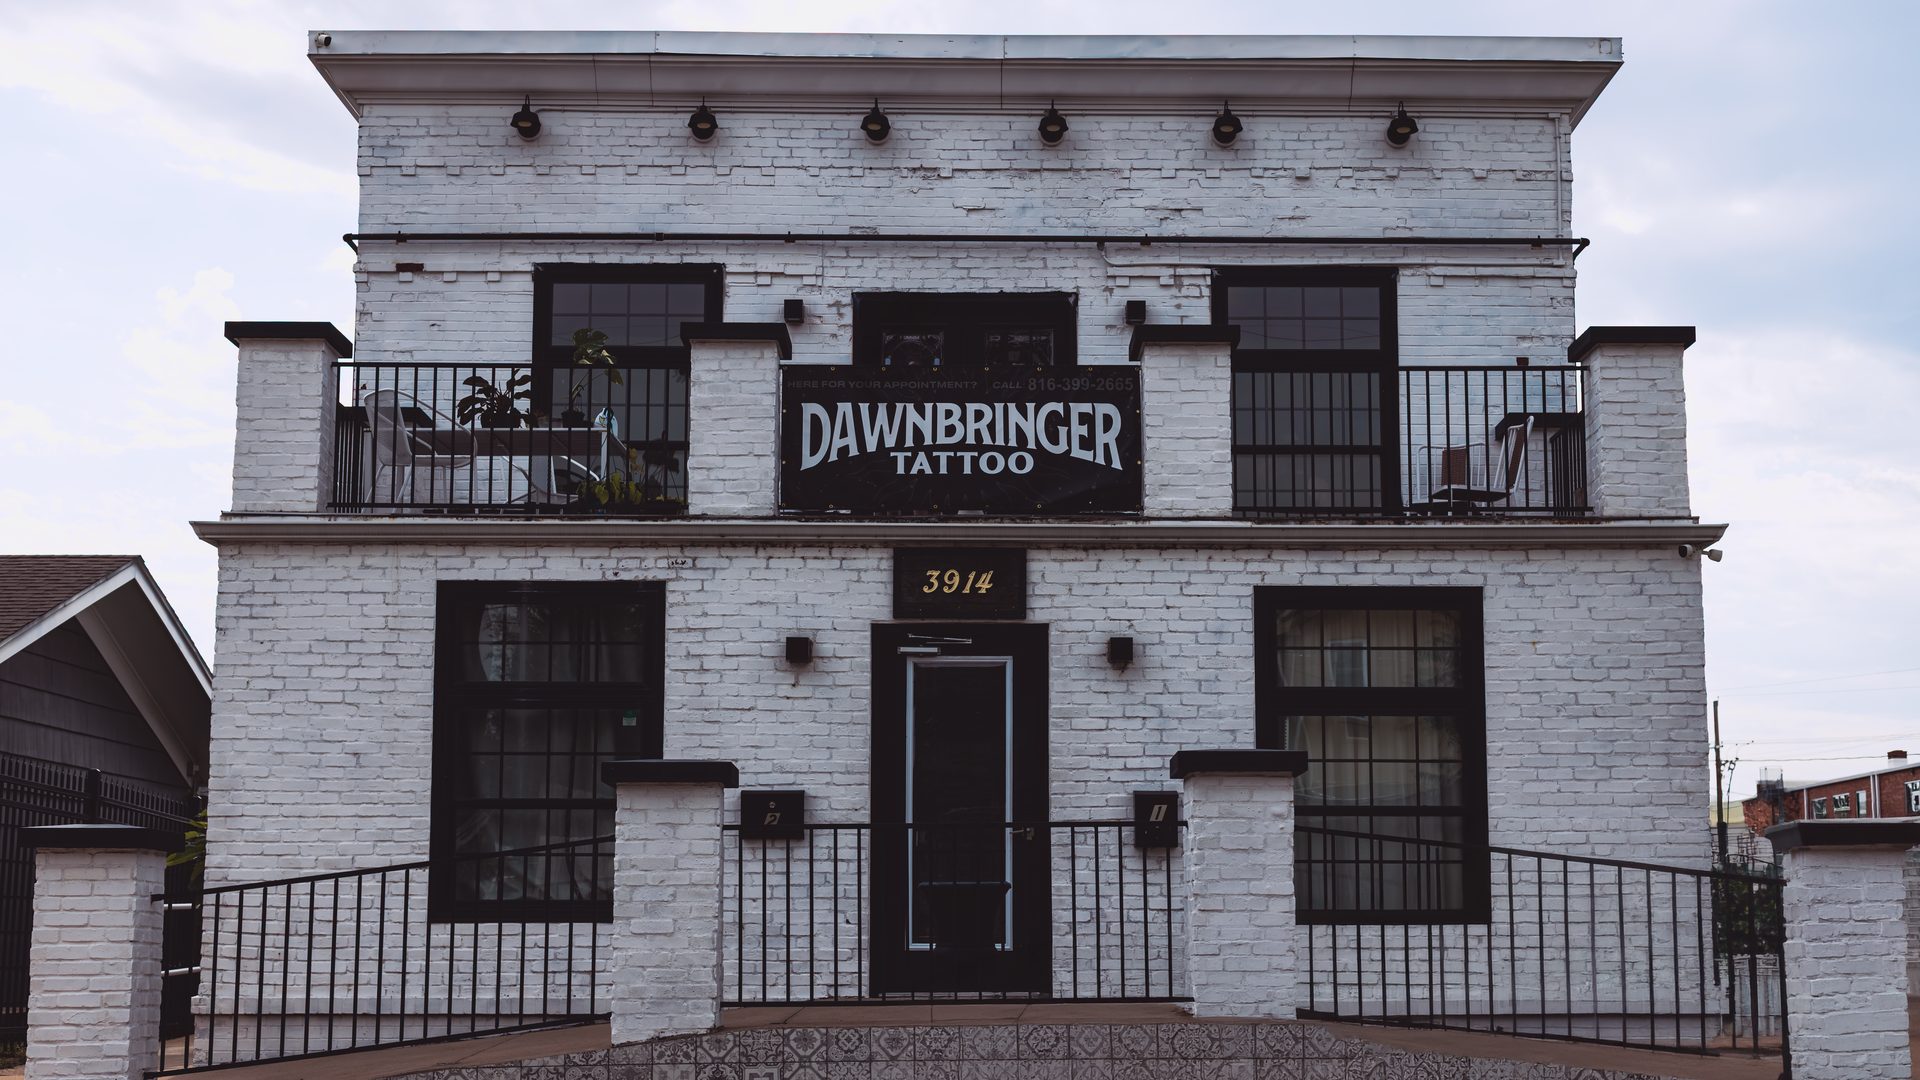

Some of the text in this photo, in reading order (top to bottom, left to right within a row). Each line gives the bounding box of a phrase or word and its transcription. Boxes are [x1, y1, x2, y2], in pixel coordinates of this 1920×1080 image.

[787, 380, 978, 390] HERE FOR YOUR APPOINTMENT?
[1028, 377, 1134, 391] 816-399-2665
[800, 402, 1123, 471] DAWNBRINGER
[890, 451, 1035, 475] TATTOO
[922, 569, 994, 594] 3914
[766, 814, 778, 825] 2
